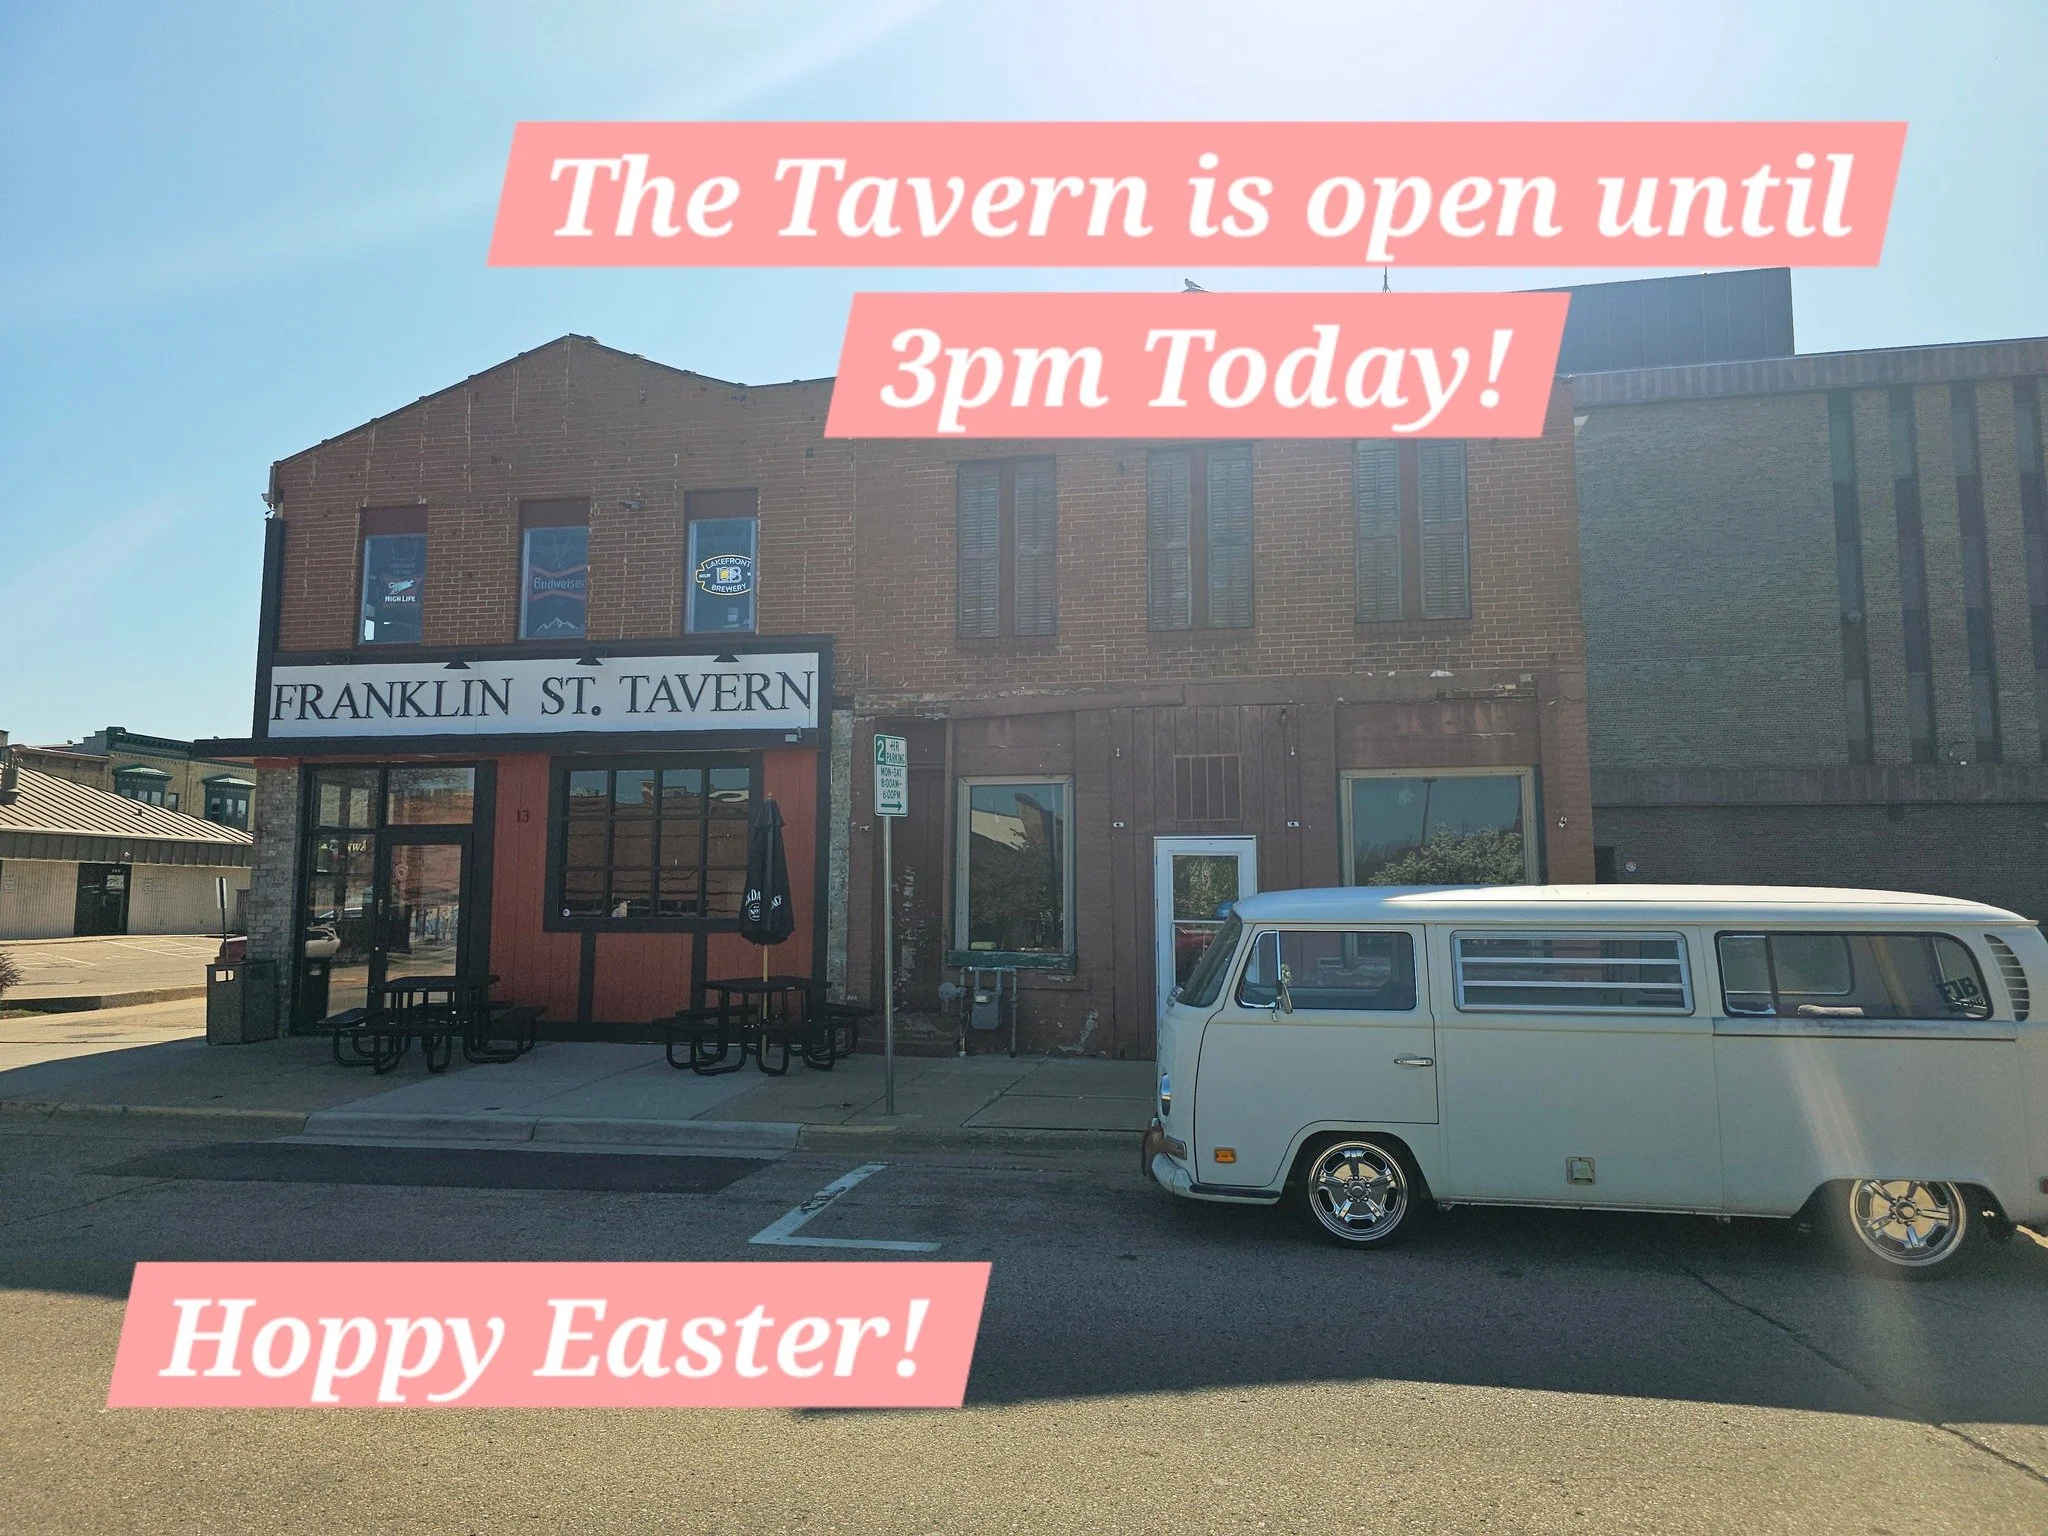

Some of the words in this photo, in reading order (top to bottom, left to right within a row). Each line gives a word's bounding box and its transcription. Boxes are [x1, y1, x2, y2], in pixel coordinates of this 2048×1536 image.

[705, 558, 751, 569] LAKEFRONT
[533, 577, 586, 590] Budweiser
[711, 583, 746, 592] BREWERY
[270, 677, 515, 721] FRANKLIN
[541, 676, 602, 716] ST.
[619, 670, 816, 713] TAVERN
[877, 740, 885, 762] 2
[890, 741, 900, 752] HR
[886, 752, 905, 765] PARKING
[881, 767, 902, 778] MON-SAT
[883, 790, 901, 800] 6:00PM
